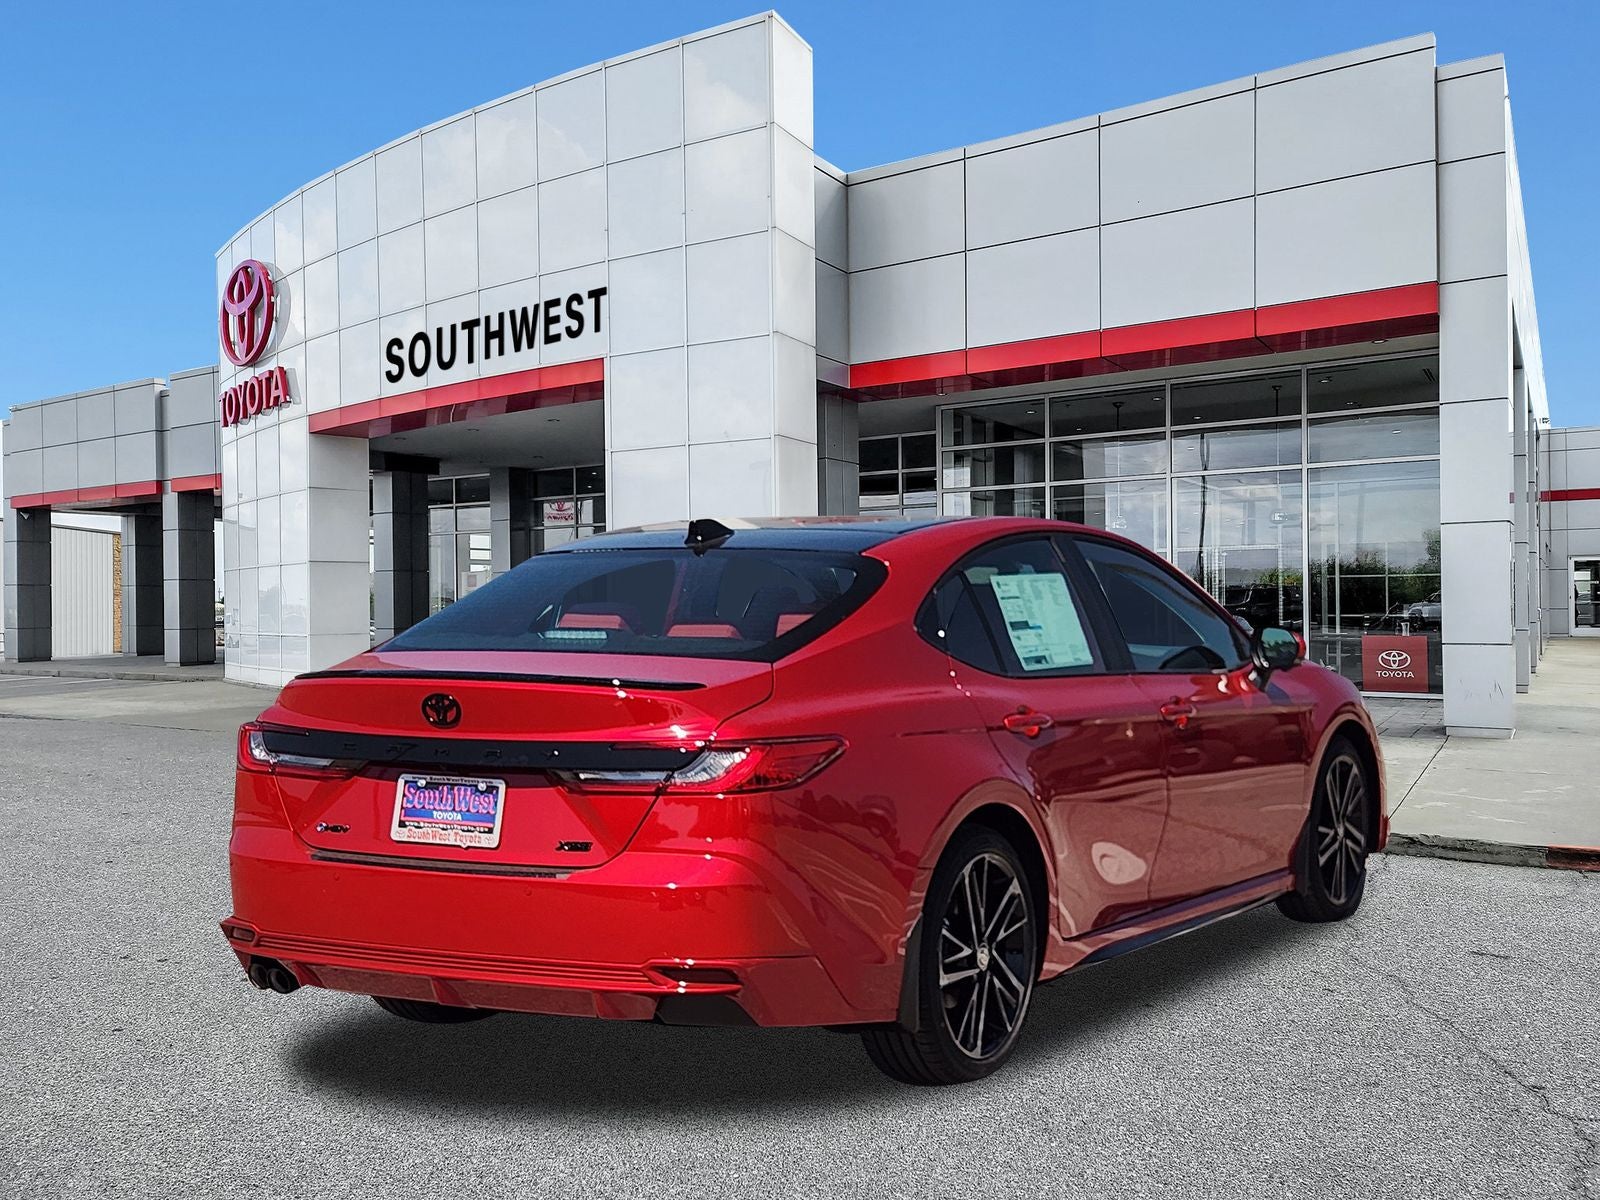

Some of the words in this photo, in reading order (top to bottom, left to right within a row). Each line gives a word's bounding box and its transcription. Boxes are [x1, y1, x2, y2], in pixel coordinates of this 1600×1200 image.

[385, 287, 608, 384] SOUTHWEST
[219, 366, 291, 428] TOYOTA
[1376, 670, 1414, 678] TOYOTA
[432, 810, 462, 821] TOYOTA
